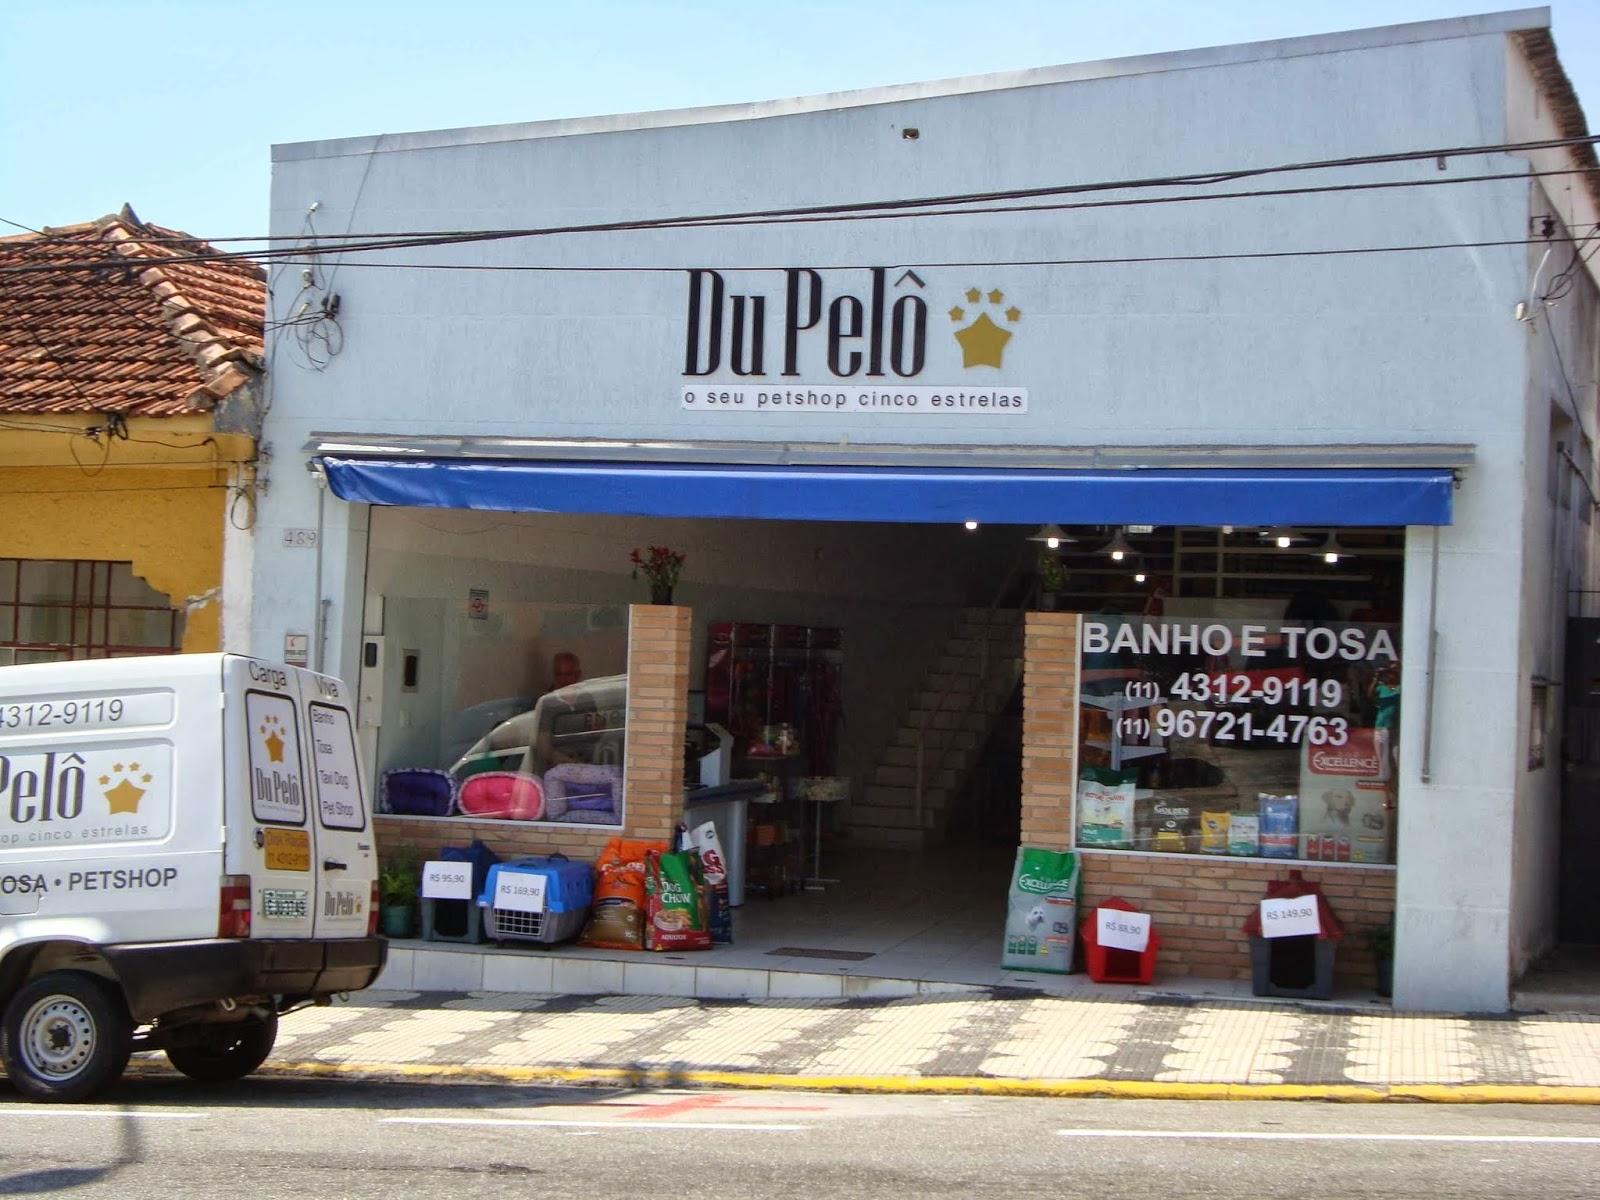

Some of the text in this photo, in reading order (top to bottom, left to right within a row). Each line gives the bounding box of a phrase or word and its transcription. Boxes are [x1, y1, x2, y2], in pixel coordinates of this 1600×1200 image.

[681, 267, 927, 377] Du Pelô
[684, 390, 1023, 408] o seu petshop cinco estrelas
[284, 531, 317, 546] 489
[1083, 622, 1398, 662] BANHO E TOSA
[248, 660, 288, 690] Carga
[1125, 671, 1342, 708] (11) 4312-9119
[1116, 708, 1348, 747] (11) 96721-4763
[256, 767, 300, 807] Du Pelô
[29, 828, 73, 843] cinco
[82, 823, 149, 839] estrelas
[0, 867, 178, 895] OSA PETSHOP
